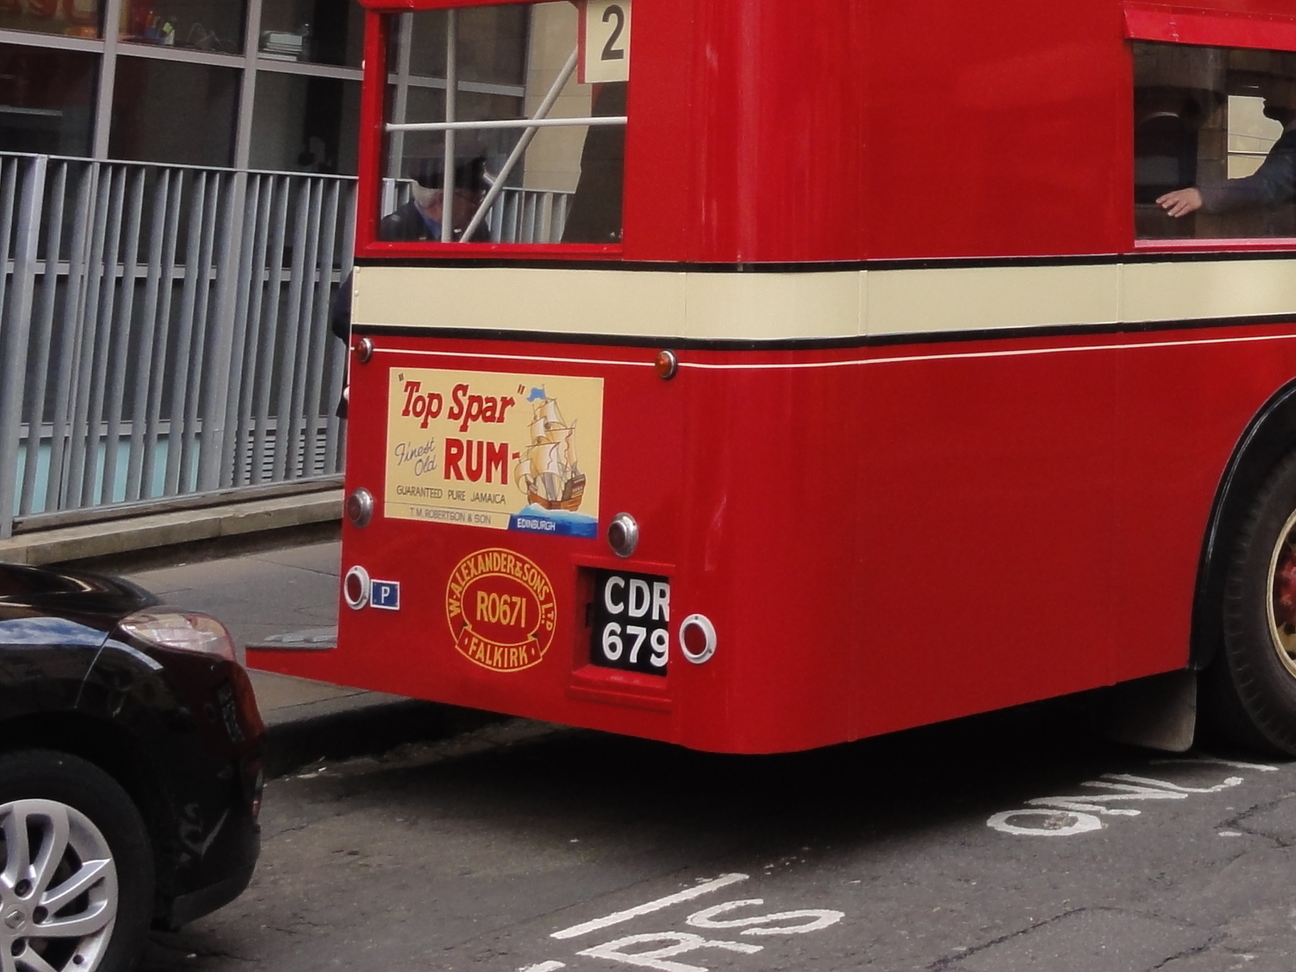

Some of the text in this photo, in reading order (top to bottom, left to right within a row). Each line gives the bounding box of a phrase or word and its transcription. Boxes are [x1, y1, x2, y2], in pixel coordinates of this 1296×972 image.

[600, 4, 625, 62] 2
[395, 437, 436, 466] Finest
[414, 454, 437, 476] Old
[396, 485, 506, 505] GUARANTEED PURE JAMAICA
[424, 508, 466, 522] ROBERTSON
[474, 515, 492, 524] SON
[517, 517, 556, 531] EDINBURGH
[381, 586, 391, 604] P
[604, 576, 670, 622] CDR
[469, 636, 529, 668] FALKIRK
[602, 622, 669, 667] 679
